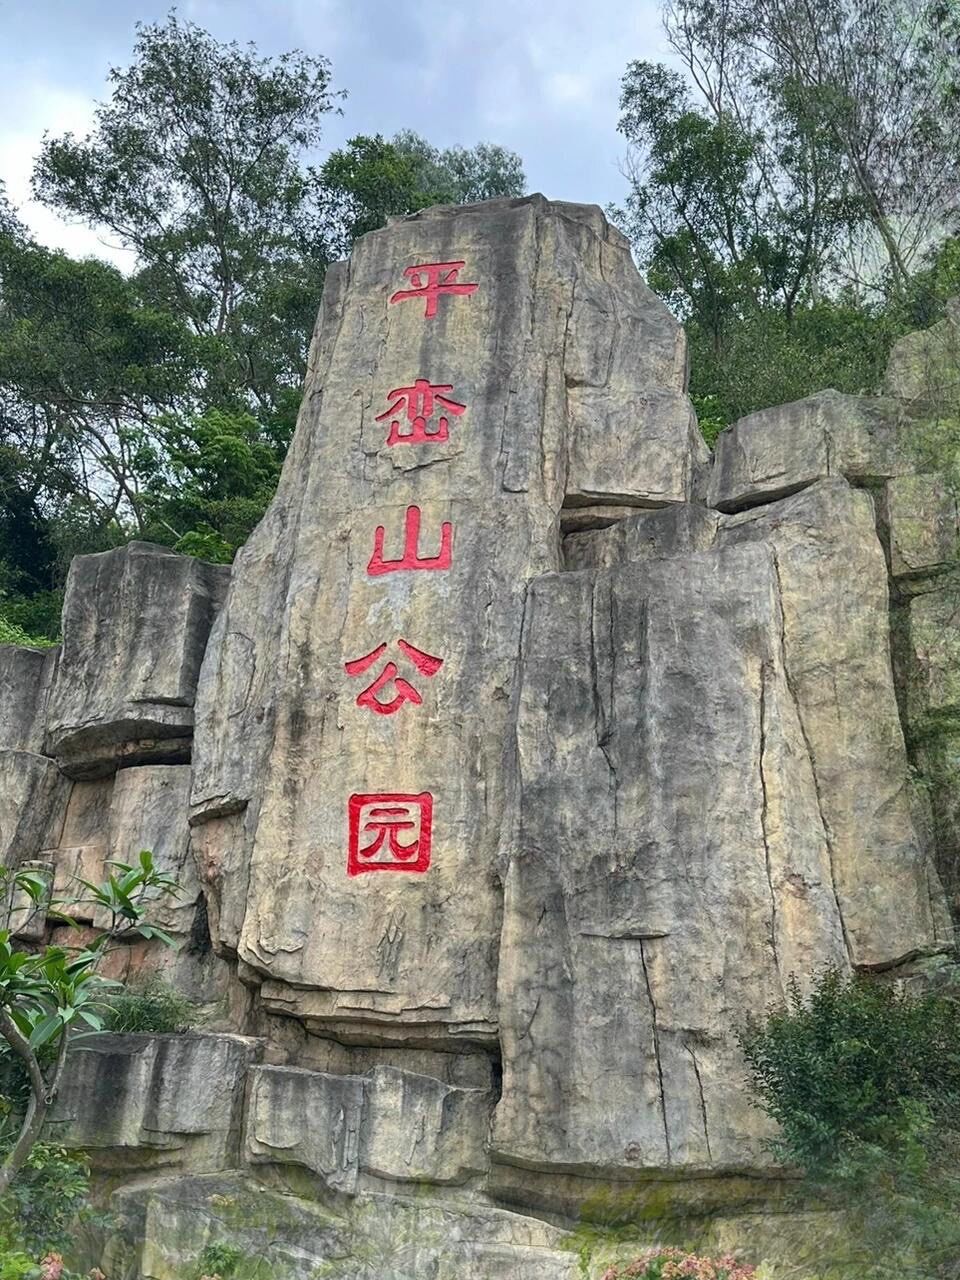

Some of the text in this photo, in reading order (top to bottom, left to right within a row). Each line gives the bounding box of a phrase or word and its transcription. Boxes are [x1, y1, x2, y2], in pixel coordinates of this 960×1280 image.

[344, 260, 479, 878] 平峦山公园
